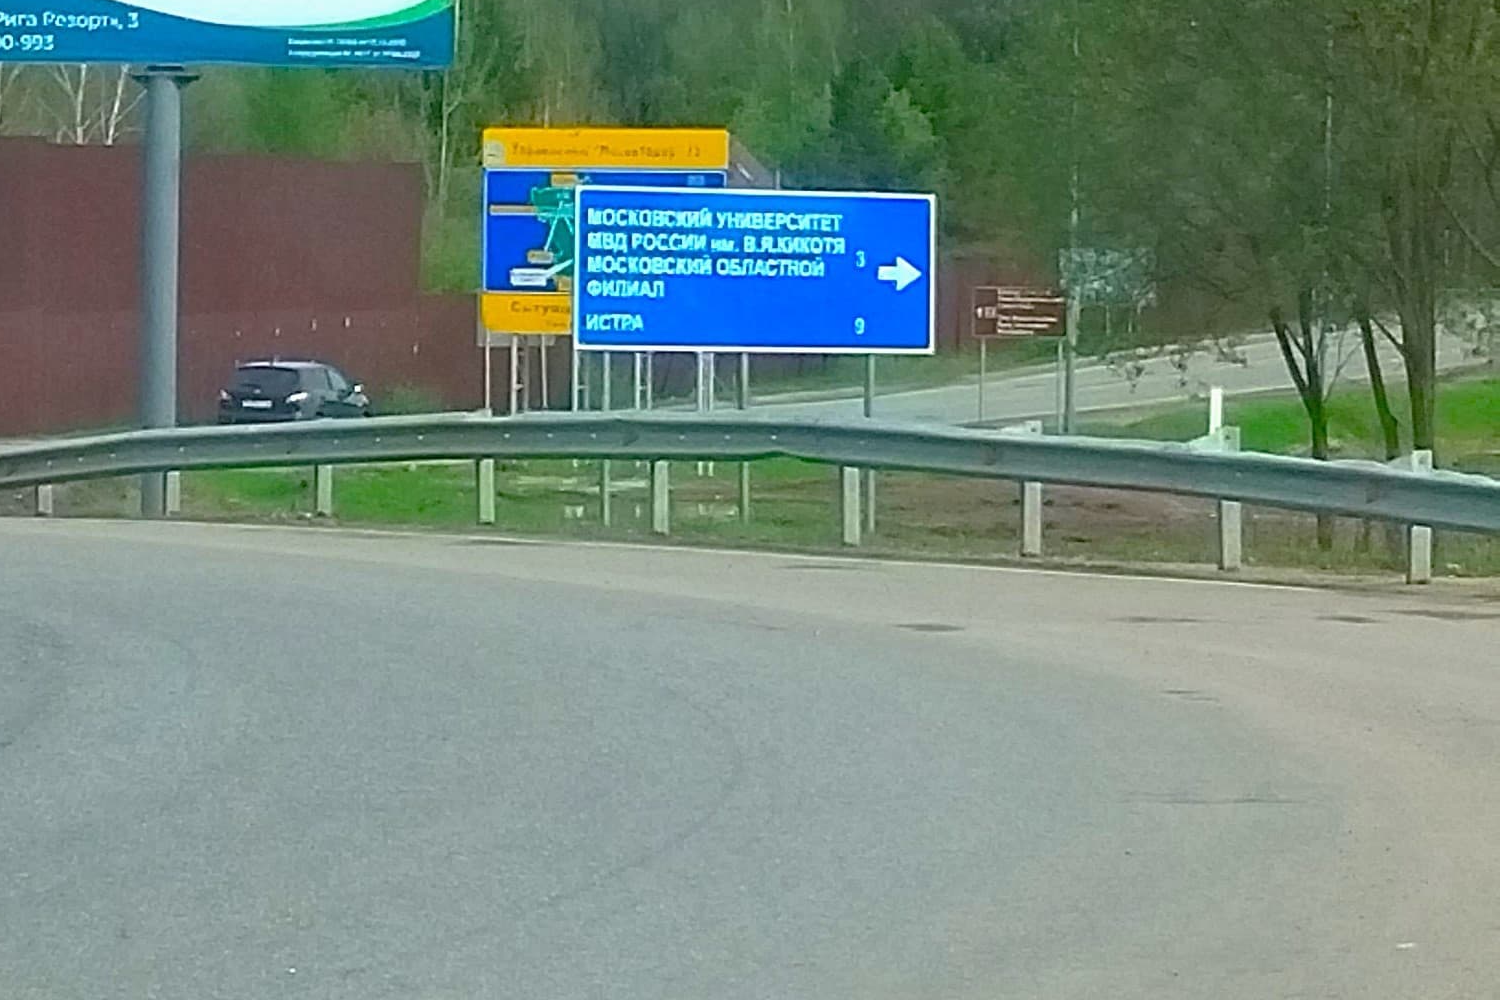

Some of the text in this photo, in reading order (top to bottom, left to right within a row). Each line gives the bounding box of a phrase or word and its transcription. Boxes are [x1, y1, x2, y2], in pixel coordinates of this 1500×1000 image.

[127, 12, 140, 29] 3
[587, 207, 843, 232] МОСКОВСКИЙ УНИВЕРСИТЕТ
[587, 232, 627, 253] МВД
[631, 232, 707, 252] РОССИИ
[710, 238, 739, 252] им.
[587, 255, 825, 277] МОСКОВСКИЙ ОБЛАСТНОЙ
[855, 250, 866, 268] 3
[586, 280, 665, 298] ФИЛИАЛ
[585, 313, 644, 332] ИСТРА
[854, 317, 865, 335] 9
